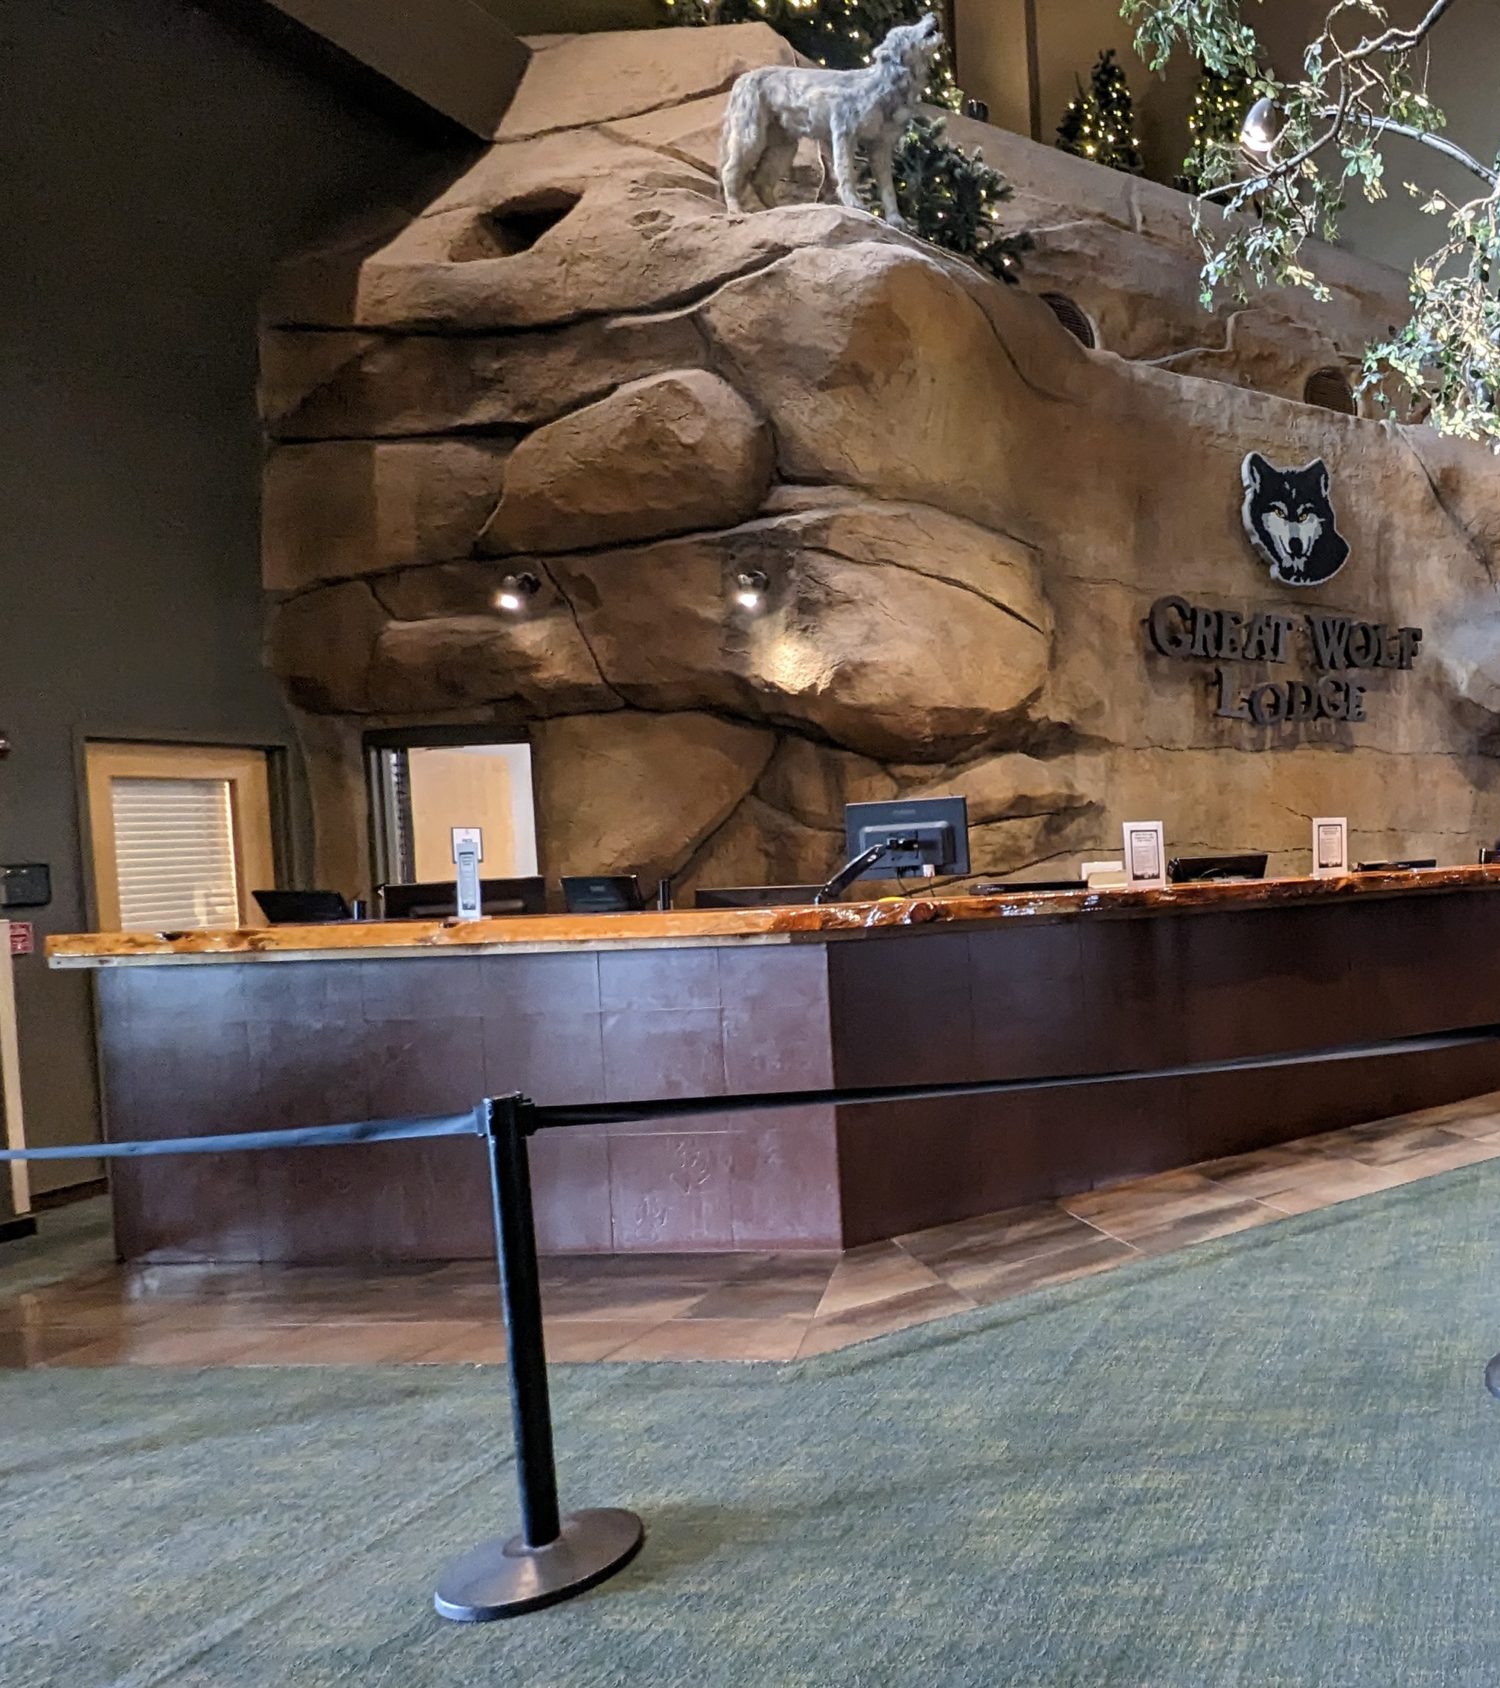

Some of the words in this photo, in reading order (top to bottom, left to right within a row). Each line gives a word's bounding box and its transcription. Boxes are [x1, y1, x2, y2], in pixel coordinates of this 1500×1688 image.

[1145, 595, 1294, 663] GREAT
[1304, 614, 1423, 670] WOLF
[1211, 666, 1367, 725] LODGE
